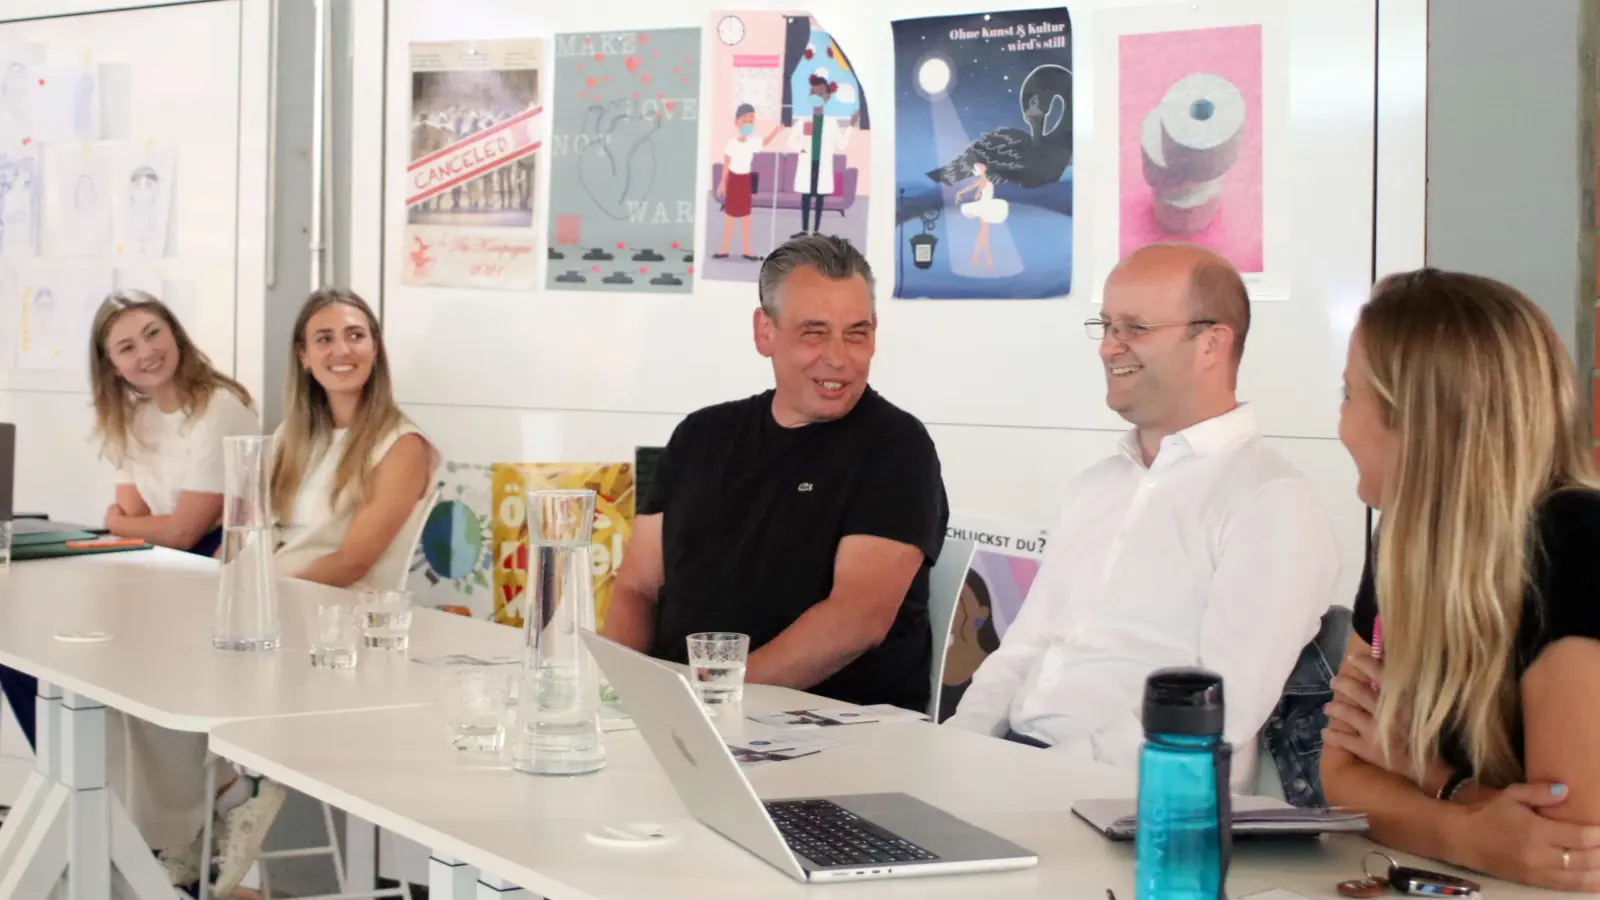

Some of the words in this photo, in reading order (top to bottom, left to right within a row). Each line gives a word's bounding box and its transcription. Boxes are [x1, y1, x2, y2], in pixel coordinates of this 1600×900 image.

[950, 28, 980, 41] Ohne
[981, 26, 1014, 39] Kunst
[1016, 25, 1026, 38] &
[1027, 21, 1066, 35] Kultur
[556, 33, 637, 57] MAKE
[1007, 38, 1042, 52] wird's
[1043, 36, 1066, 49] still
[622, 98, 698, 121] LOVE
[552, 134, 612, 157] NOT
[414, 136, 508, 190] CANCELED
[627, 201, 696, 224] WAR
[946, 527, 1011, 548] CHLUCKST
[1015, 538, 1047, 553] DU?
